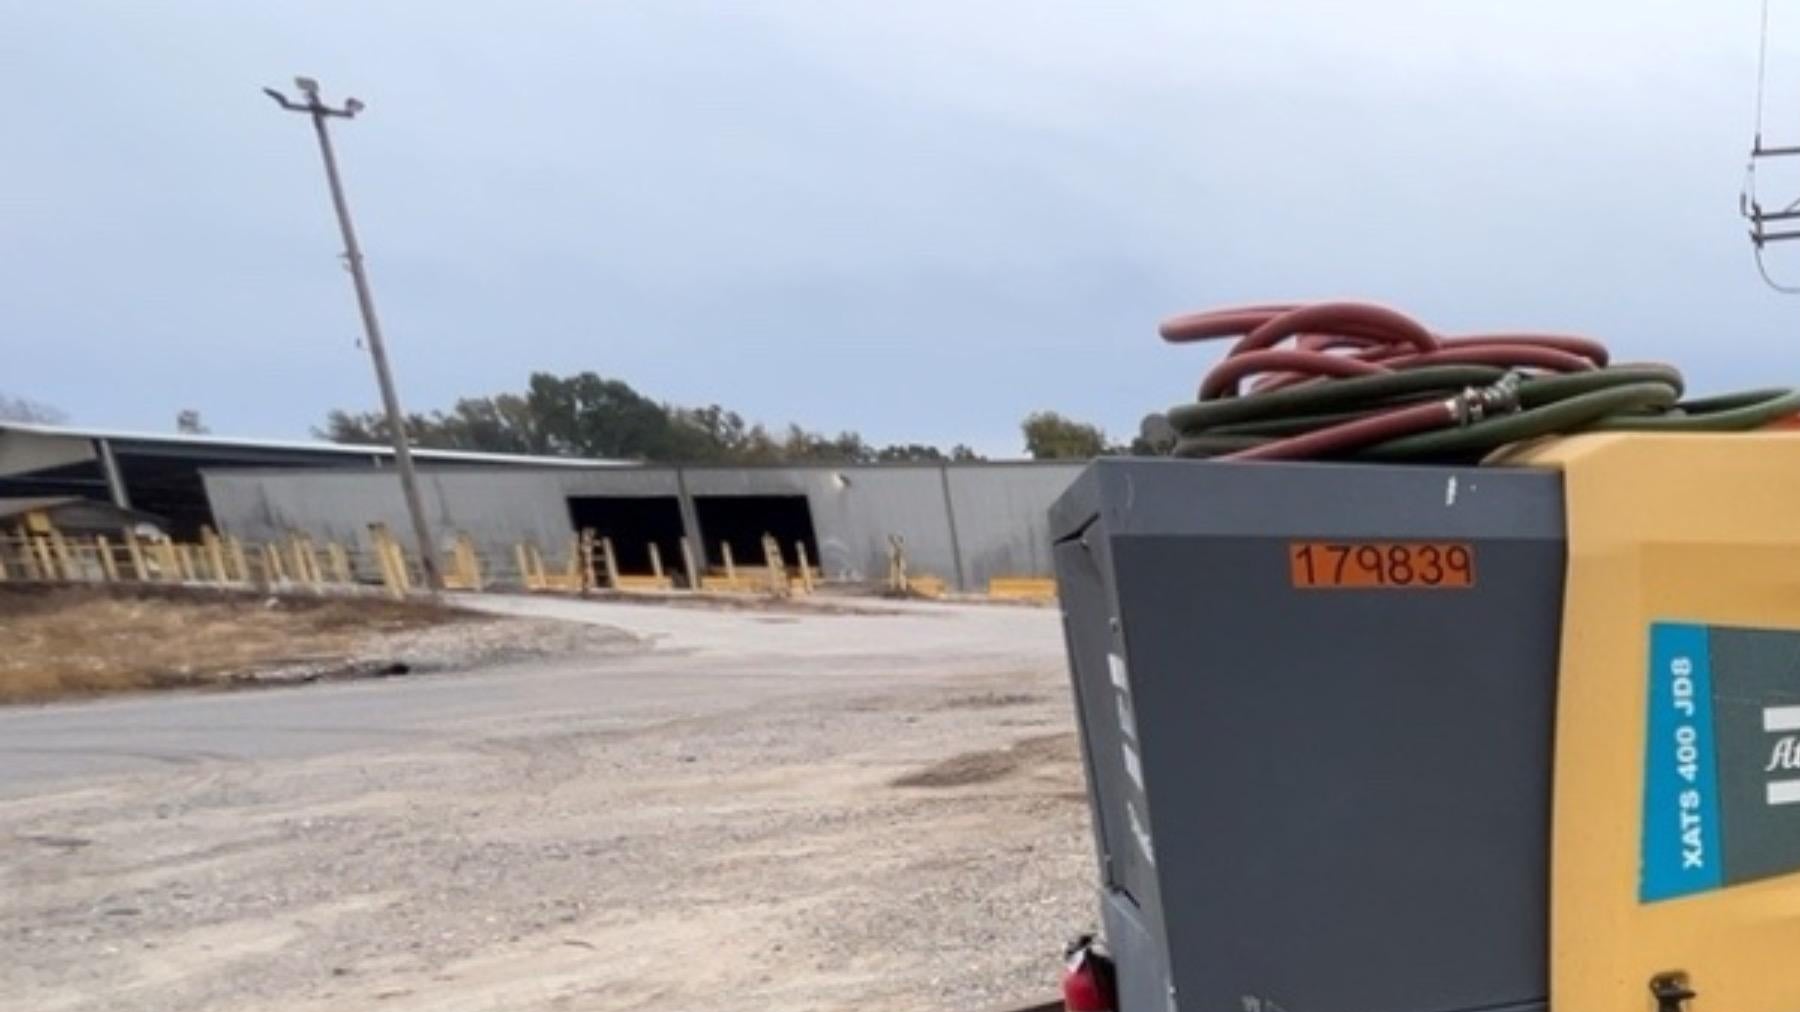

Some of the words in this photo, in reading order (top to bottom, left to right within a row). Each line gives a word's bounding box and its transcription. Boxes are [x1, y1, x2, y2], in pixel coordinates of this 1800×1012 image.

[1295, 544, 1472, 585] 179839
[1675, 725, 1698, 782] 400
[1679, 789, 1703, 869] XATS
